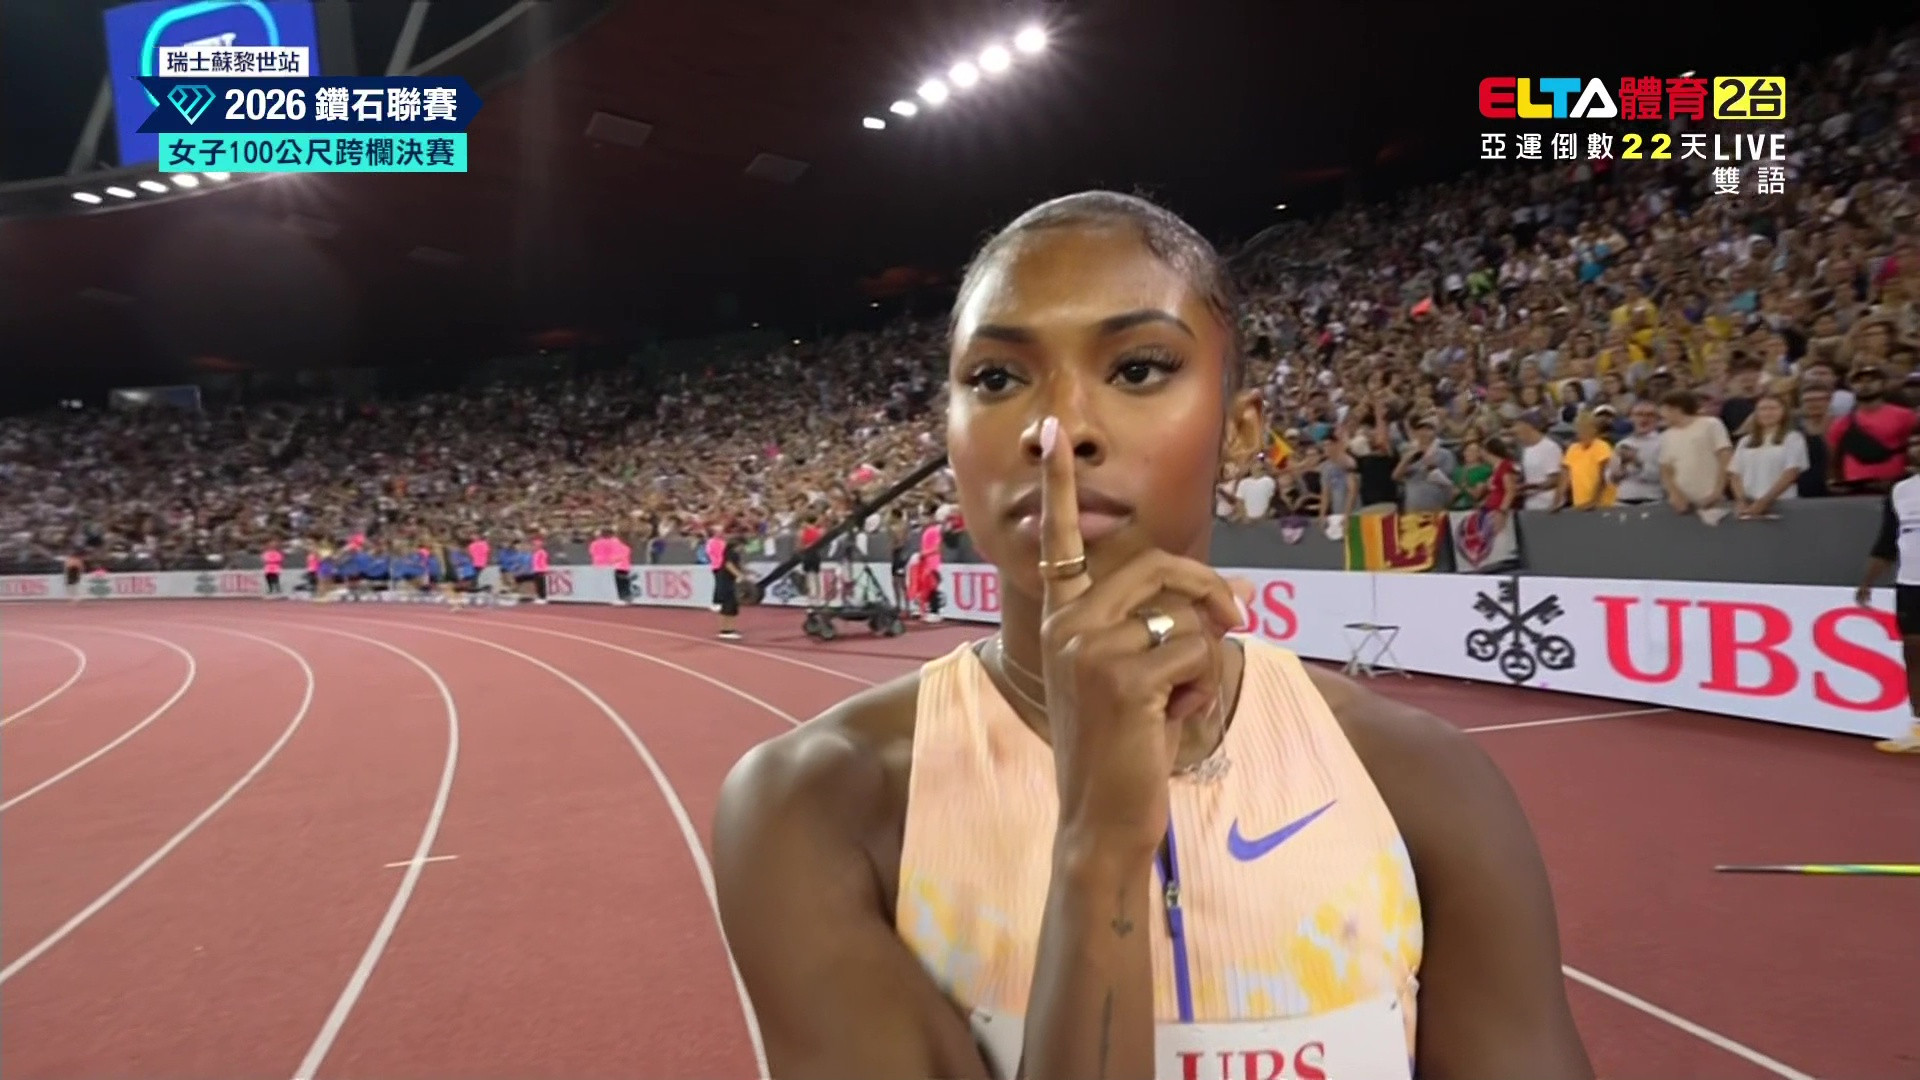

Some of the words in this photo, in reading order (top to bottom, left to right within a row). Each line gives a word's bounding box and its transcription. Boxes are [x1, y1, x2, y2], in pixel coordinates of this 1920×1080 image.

[548, 570, 573, 596] BS
[645, 570, 692, 599] UBS
[952, 571, 1000, 613] UB
[1594, 594, 1908, 713] UBS
